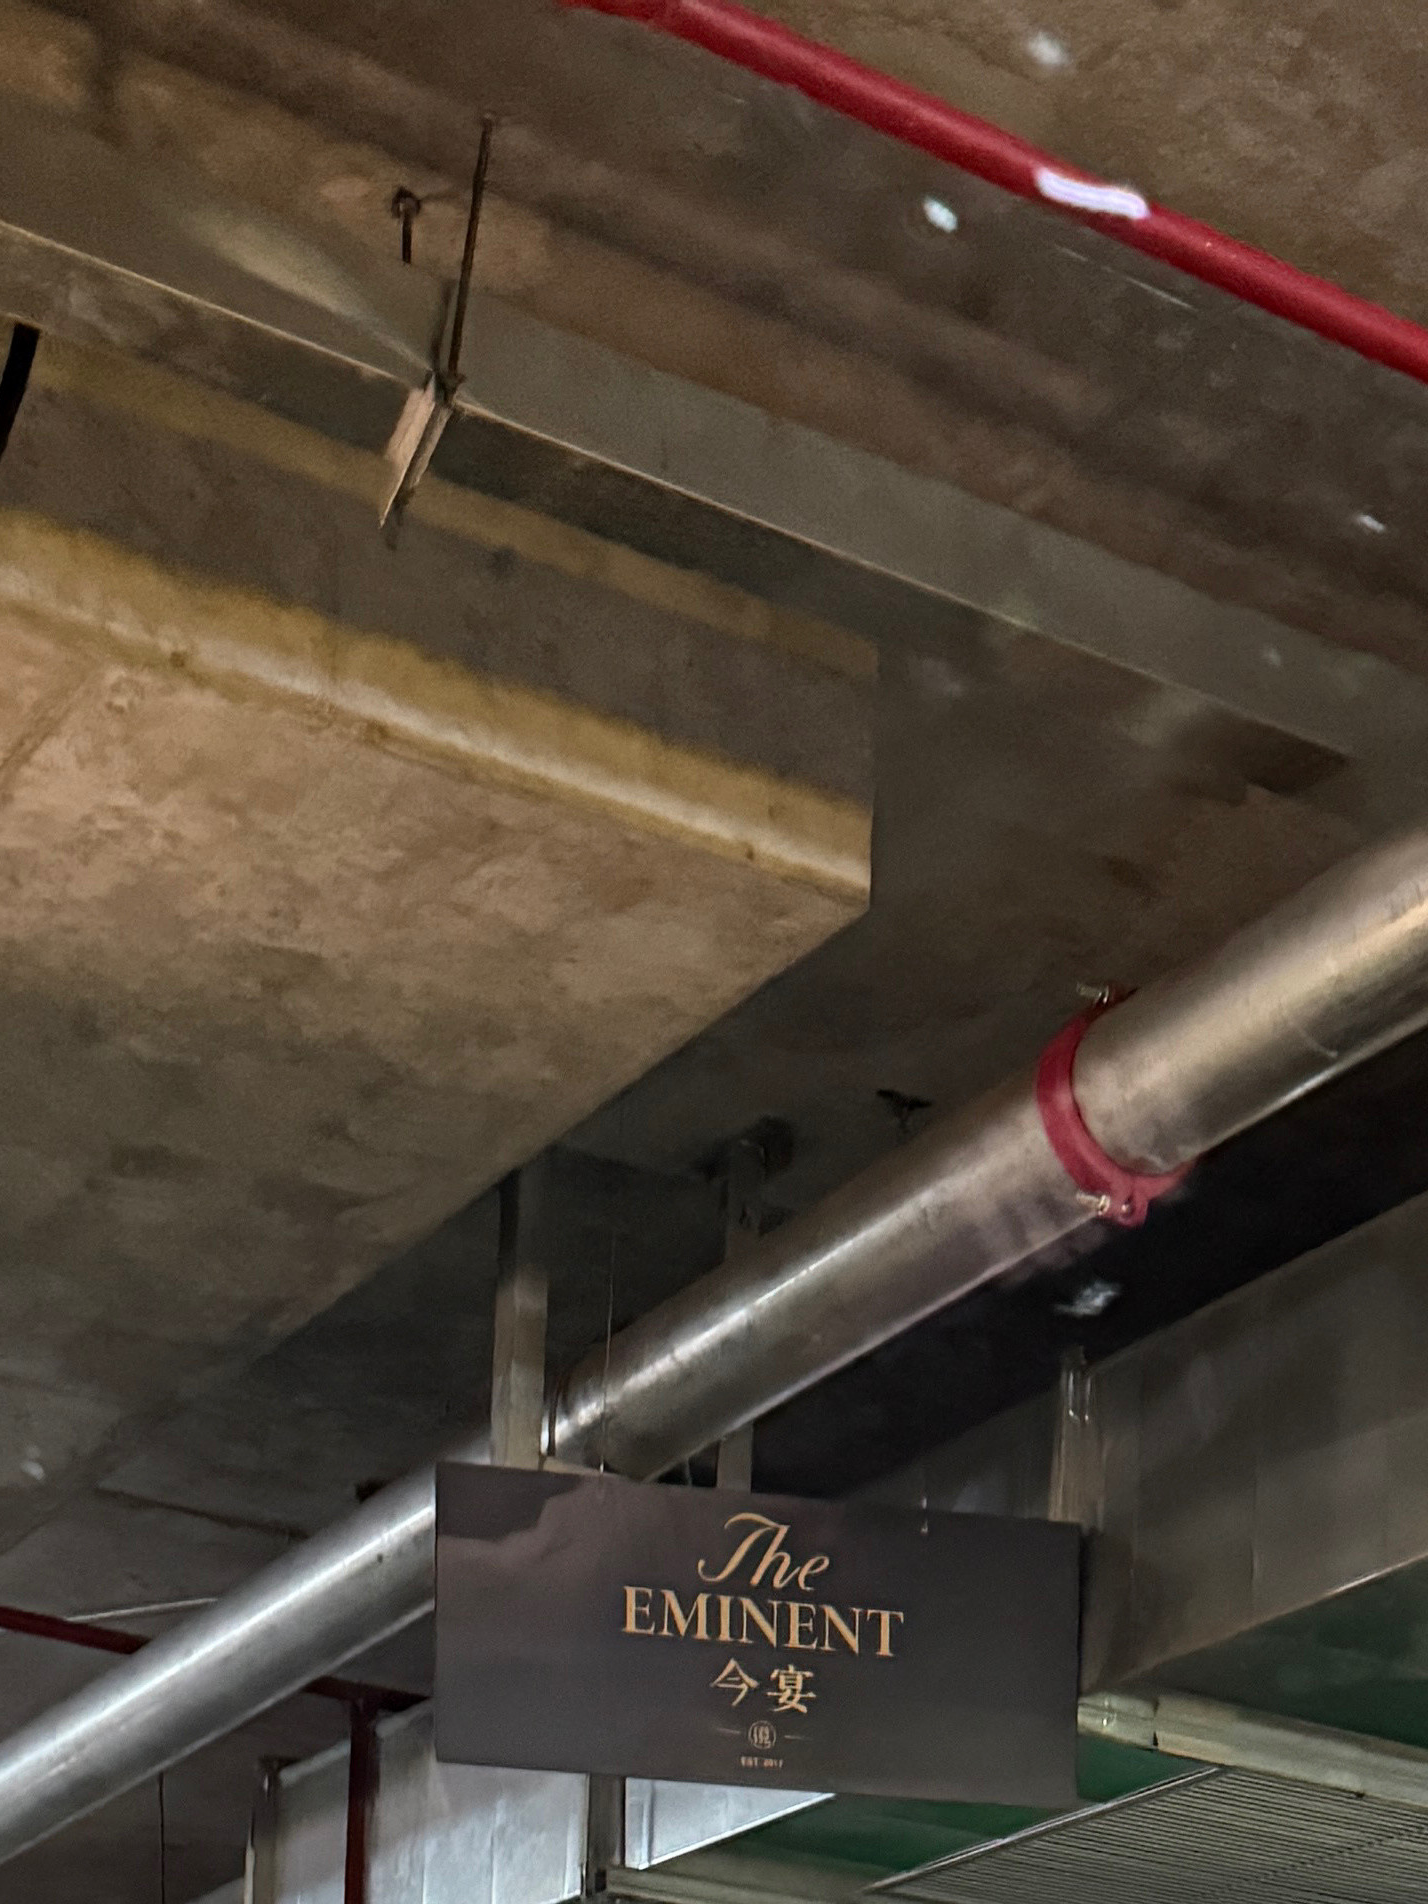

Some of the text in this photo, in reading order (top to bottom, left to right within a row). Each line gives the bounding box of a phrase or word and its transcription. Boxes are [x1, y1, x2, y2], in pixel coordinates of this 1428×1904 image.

[697, 1513, 830, 1591] The
[622, 1586, 904, 1657] EMINENT
[710, 1658, 816, 1713] 今宴
